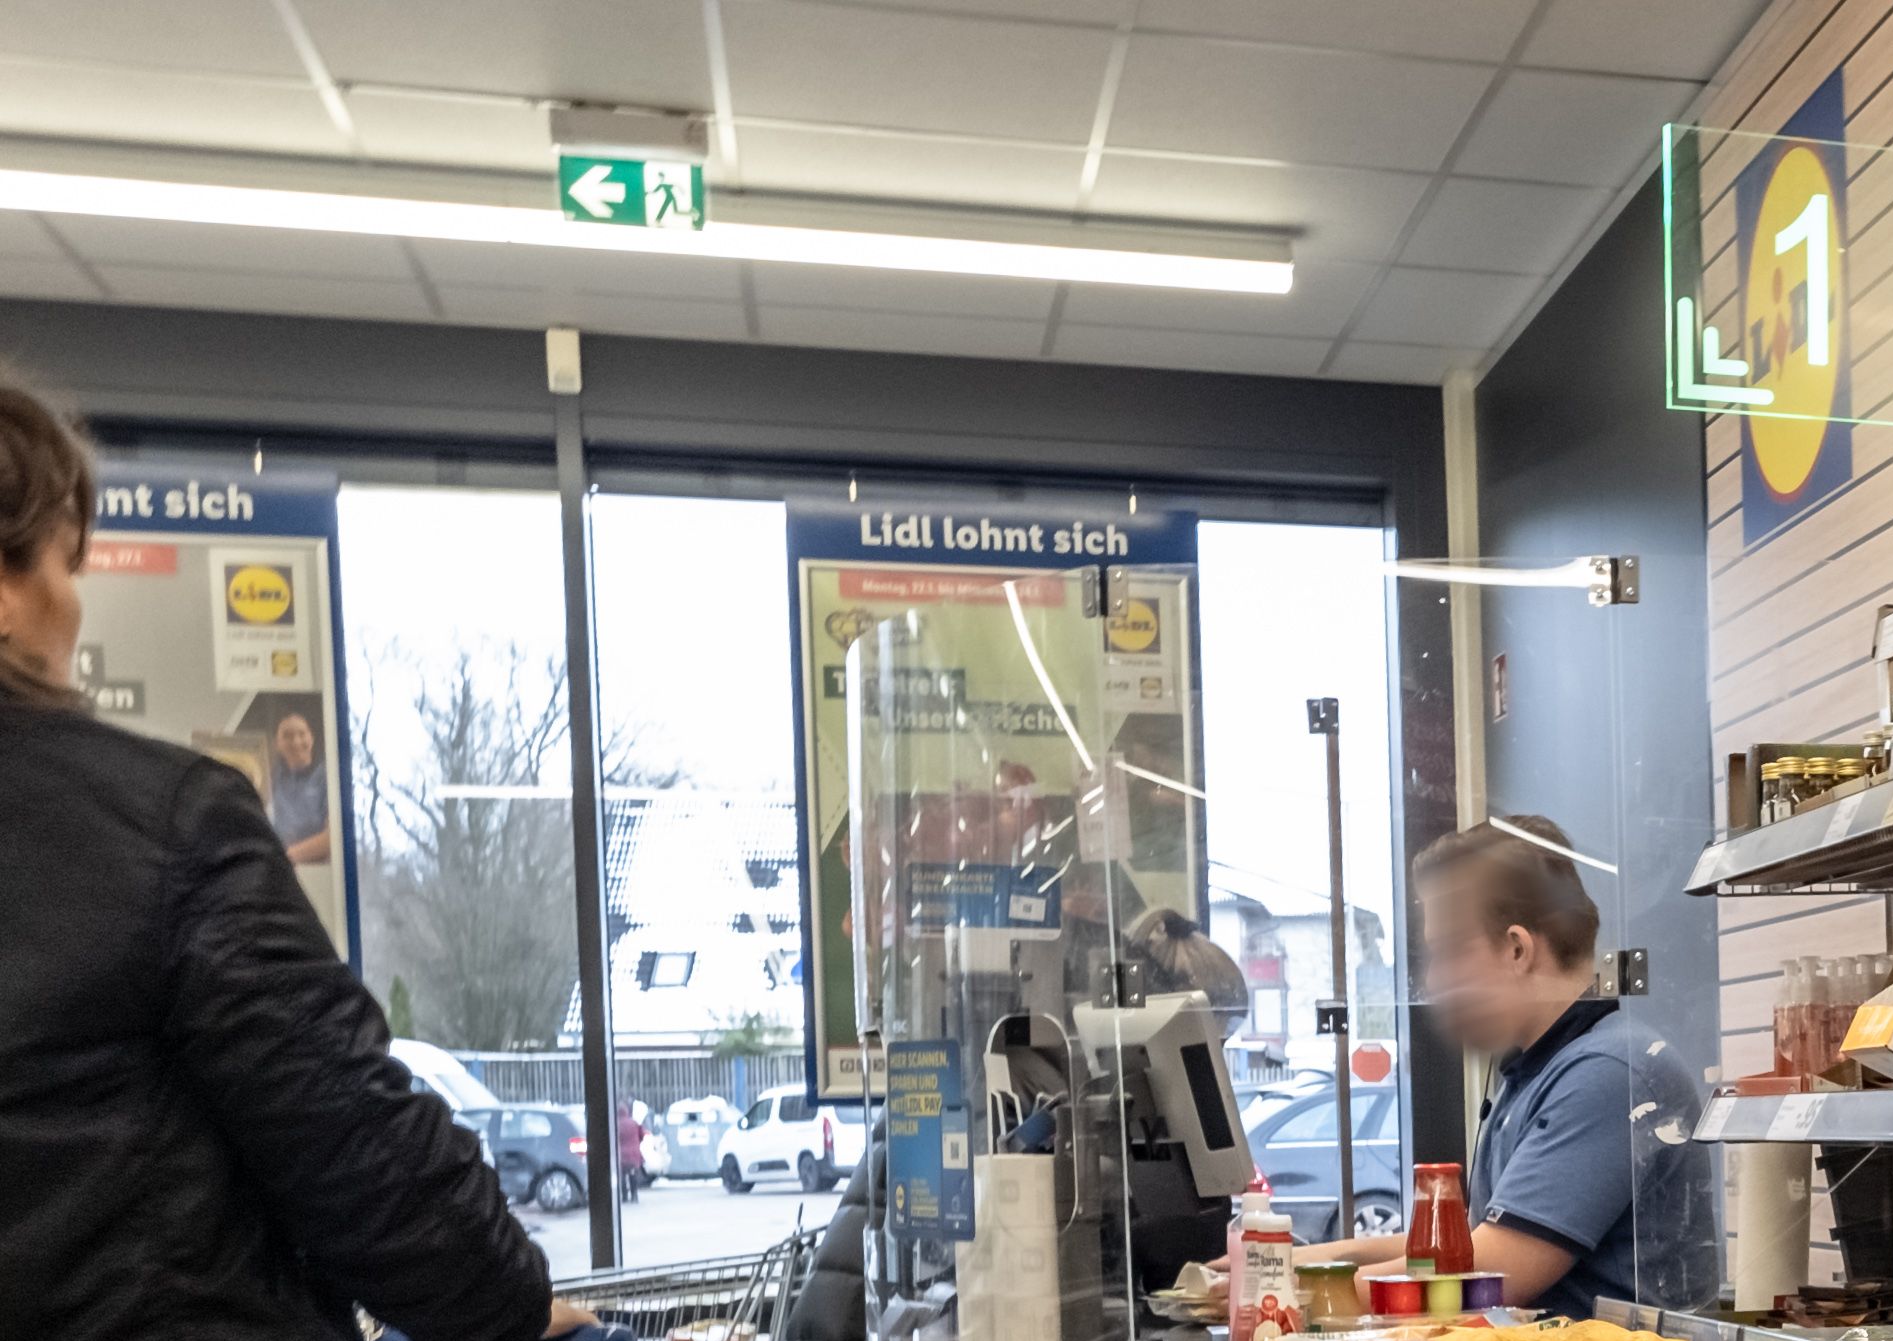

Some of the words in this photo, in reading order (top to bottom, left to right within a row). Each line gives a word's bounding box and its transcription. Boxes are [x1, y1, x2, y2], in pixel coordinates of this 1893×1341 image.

[1775, 193, 1829, 366] 1
[164, 480, 254, 521] sich
[861, 512, 934, 549] Lidl
[943, 516, 1044, 553] lohnt
[1053, 521, 1128, 556] sich
